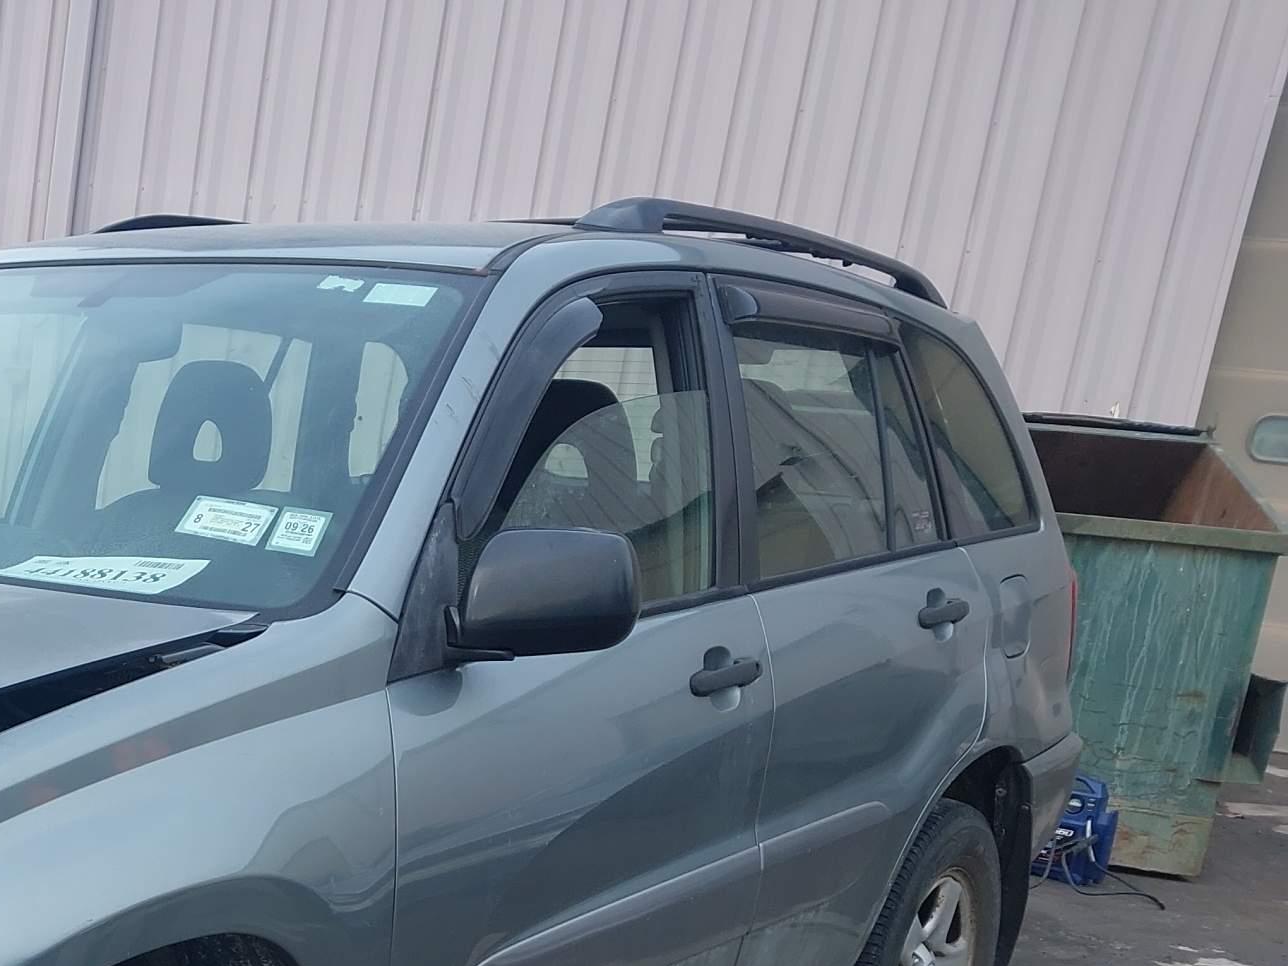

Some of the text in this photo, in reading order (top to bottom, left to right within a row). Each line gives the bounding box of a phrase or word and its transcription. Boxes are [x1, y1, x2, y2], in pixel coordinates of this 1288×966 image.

[193, 513, 204, 524] 8
[241, 521, 261, 533] 27
[284, 521, 299, 531] 09
[300, 523, 315, 534] 26
[24, 567, 167, 583] 44188138
